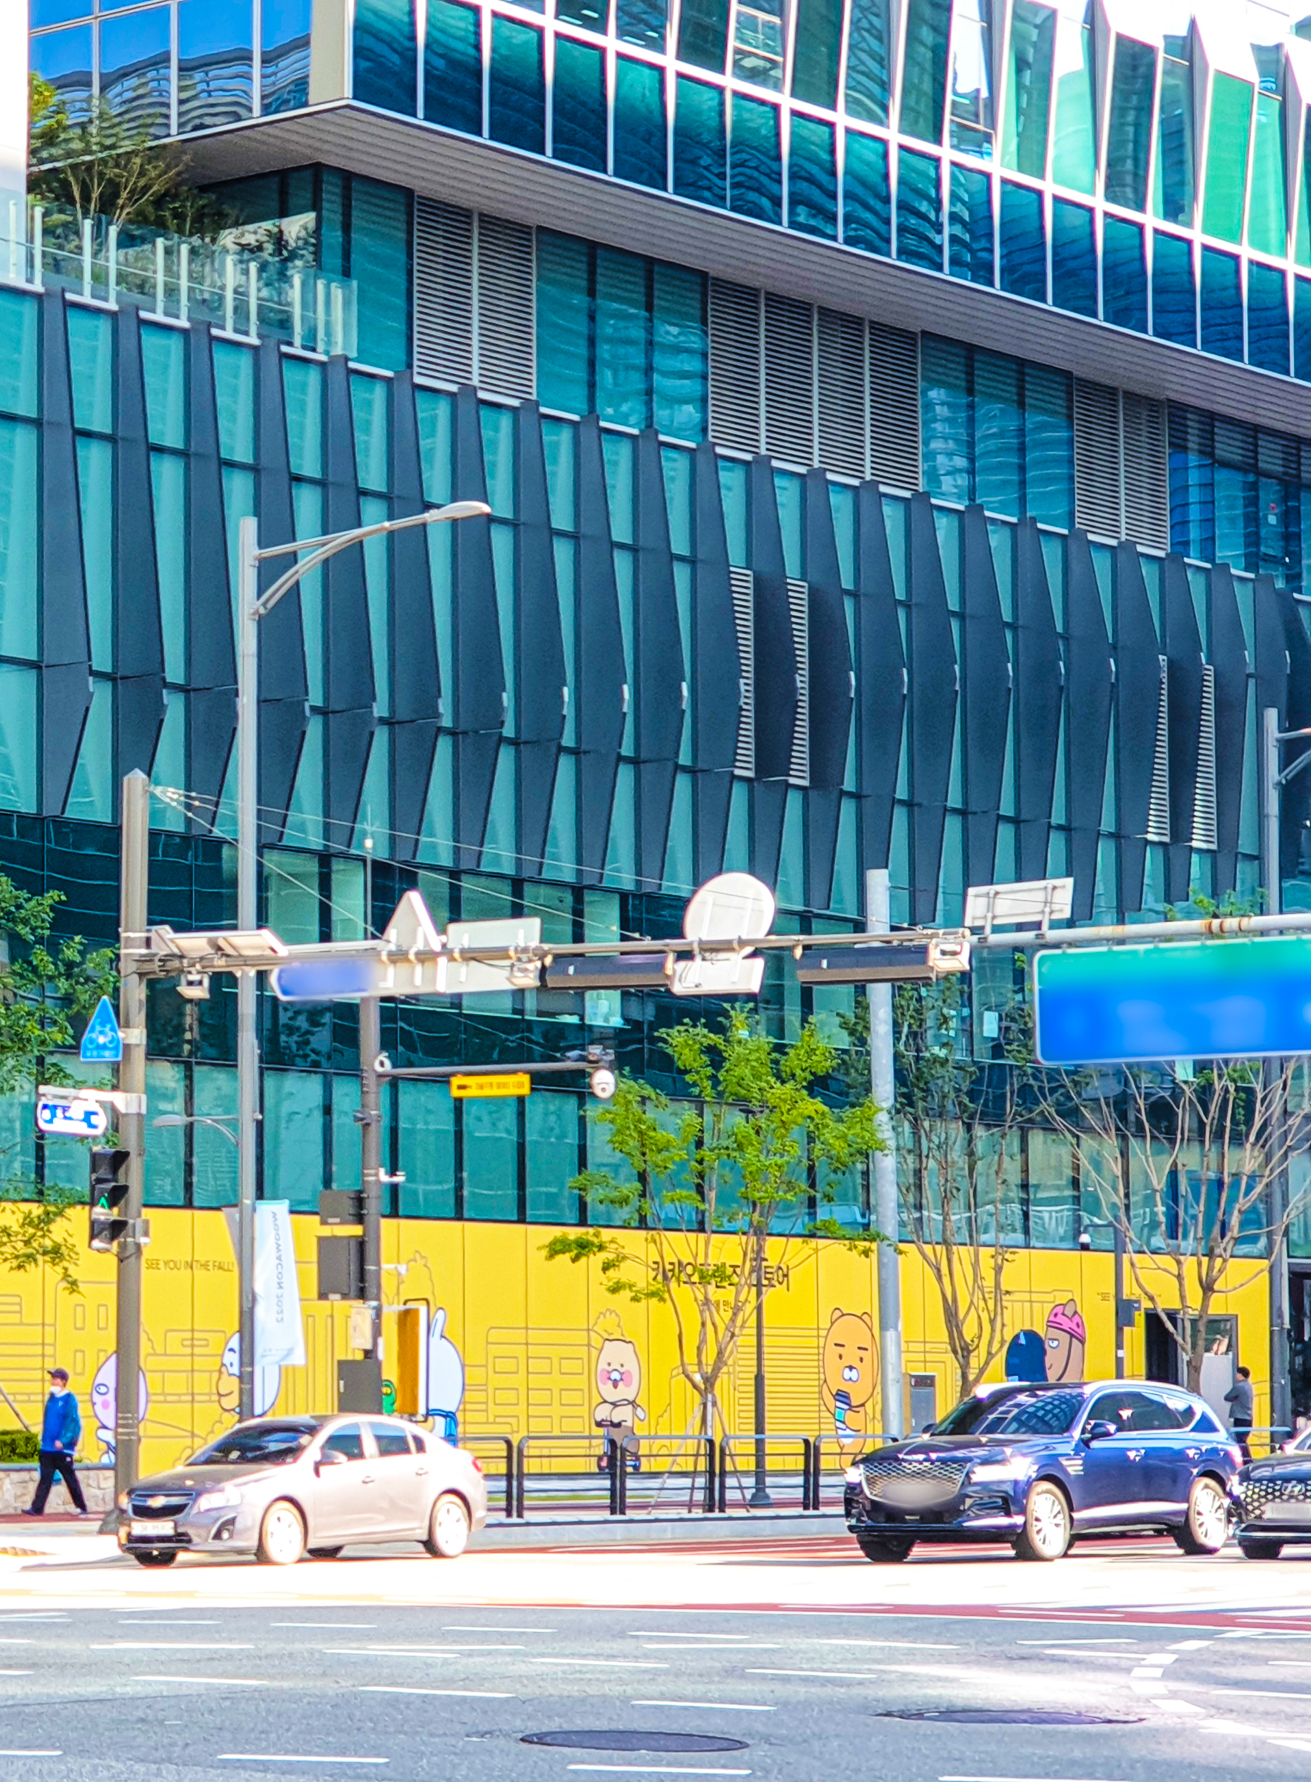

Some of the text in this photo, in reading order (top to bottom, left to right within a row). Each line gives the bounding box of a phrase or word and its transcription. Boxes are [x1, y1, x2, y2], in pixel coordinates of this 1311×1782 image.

[144, 1258, 235, 1273] SEE YOU IN THE FALL!
